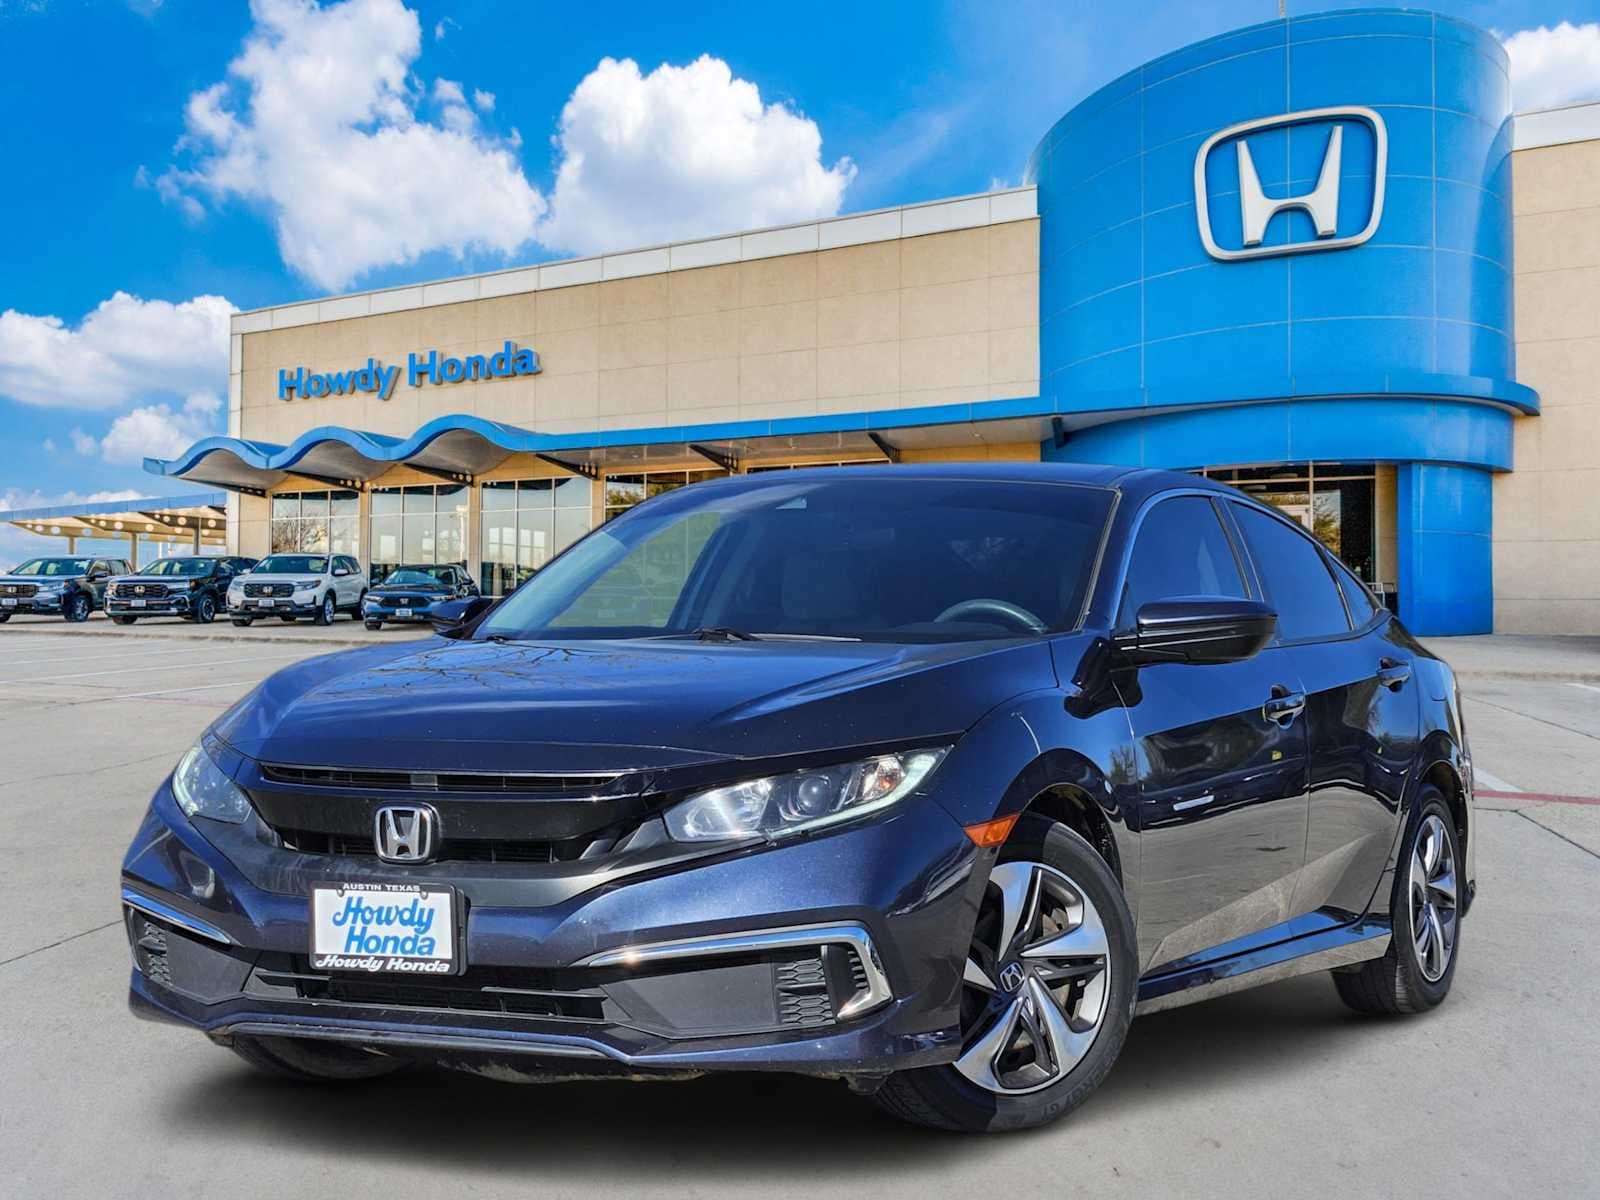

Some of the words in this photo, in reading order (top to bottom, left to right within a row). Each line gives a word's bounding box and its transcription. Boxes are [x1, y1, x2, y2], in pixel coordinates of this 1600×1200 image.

[278, 357, 401, 401] Howdy
[408, 340, 542, 388] Honda
[342, 883, 382, 891] AUSTIN
[385, 884, 421, 892] TEXAS
[332, 895, 435, 935] Howdy
[344, 926, 436, 956] Honda
[315, 953, 384, 972] Howdy
[385, 957, 450, 973] Honda
